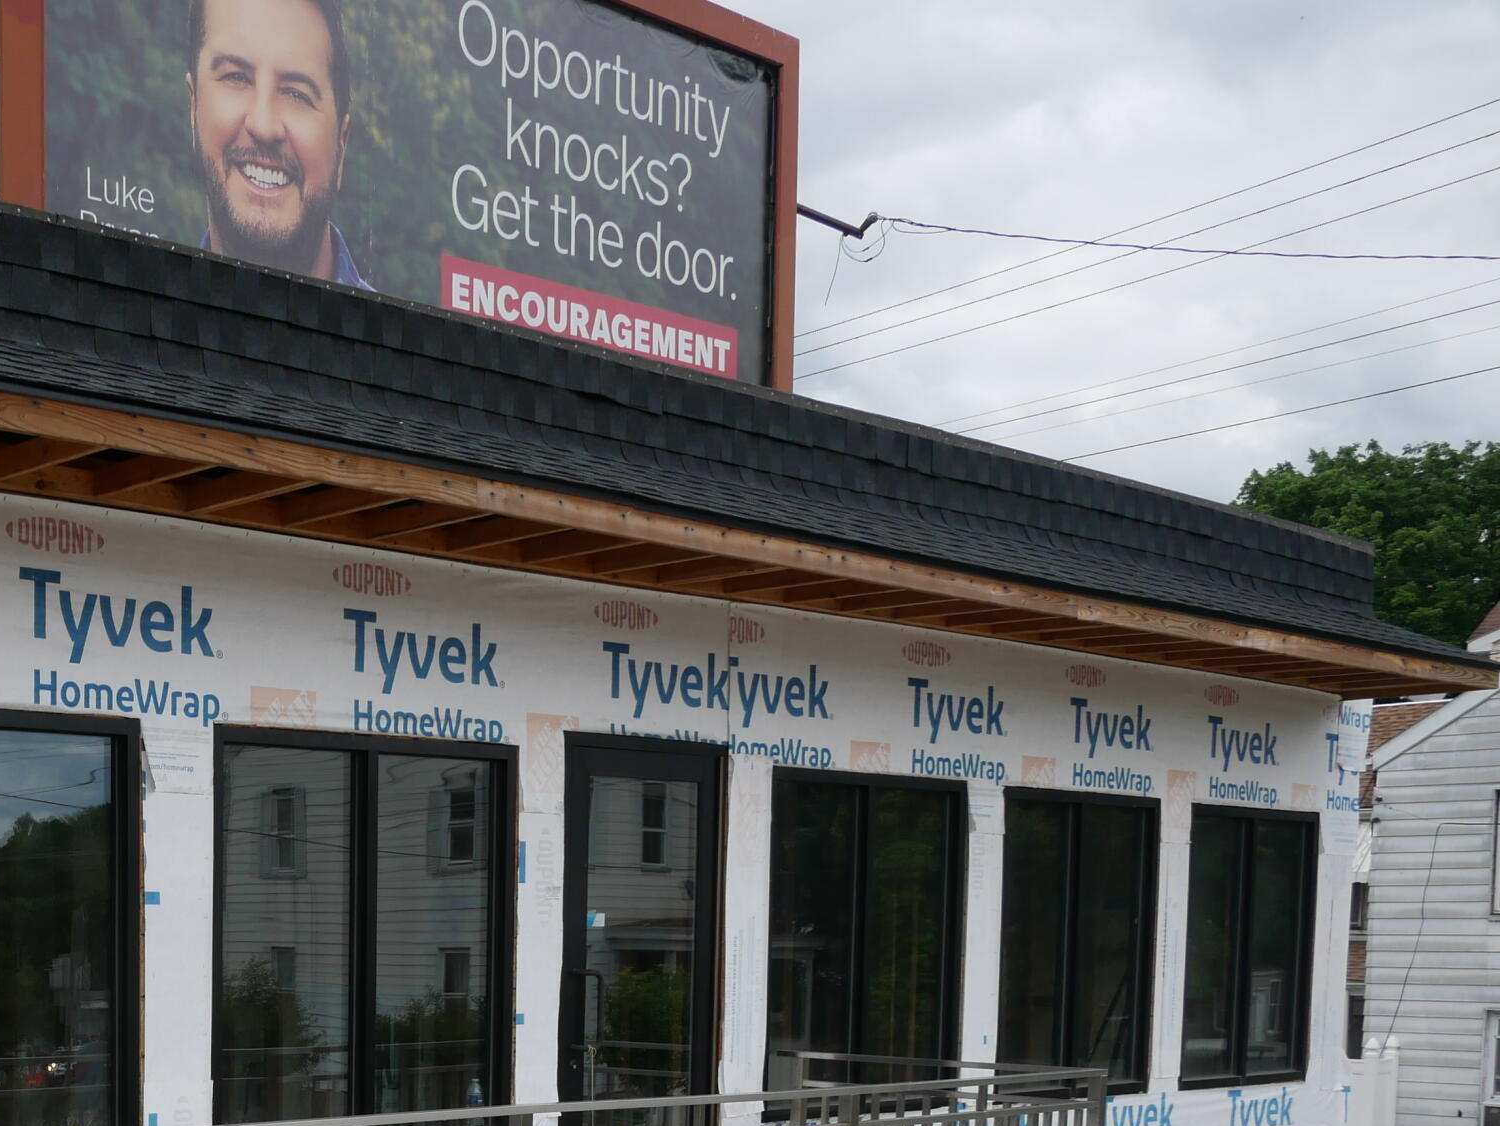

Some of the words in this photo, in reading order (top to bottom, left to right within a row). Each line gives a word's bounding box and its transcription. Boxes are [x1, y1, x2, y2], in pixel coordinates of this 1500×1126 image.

[458, 0, 730, 158] Opportunity
[507, 97, 692, 213] knocks?
[86, 166, 155, 213] Luke
[452, 164, 540, 247] Get
[550, 194, 624, 268] the
[636, 221, 737, 301] door.
[451, 272, 731, 372] ENCOURAGEMENT
[18, 516, 94, 554] DUPONT
[342, 563, 403, 597] DUPONT
[602, 601, 652, 631] DUPONT
[730, 615, 759, 645] PONT
[908, 641, 946, 667] DUPONT
[603, 641, 729, 718] Tyvek
